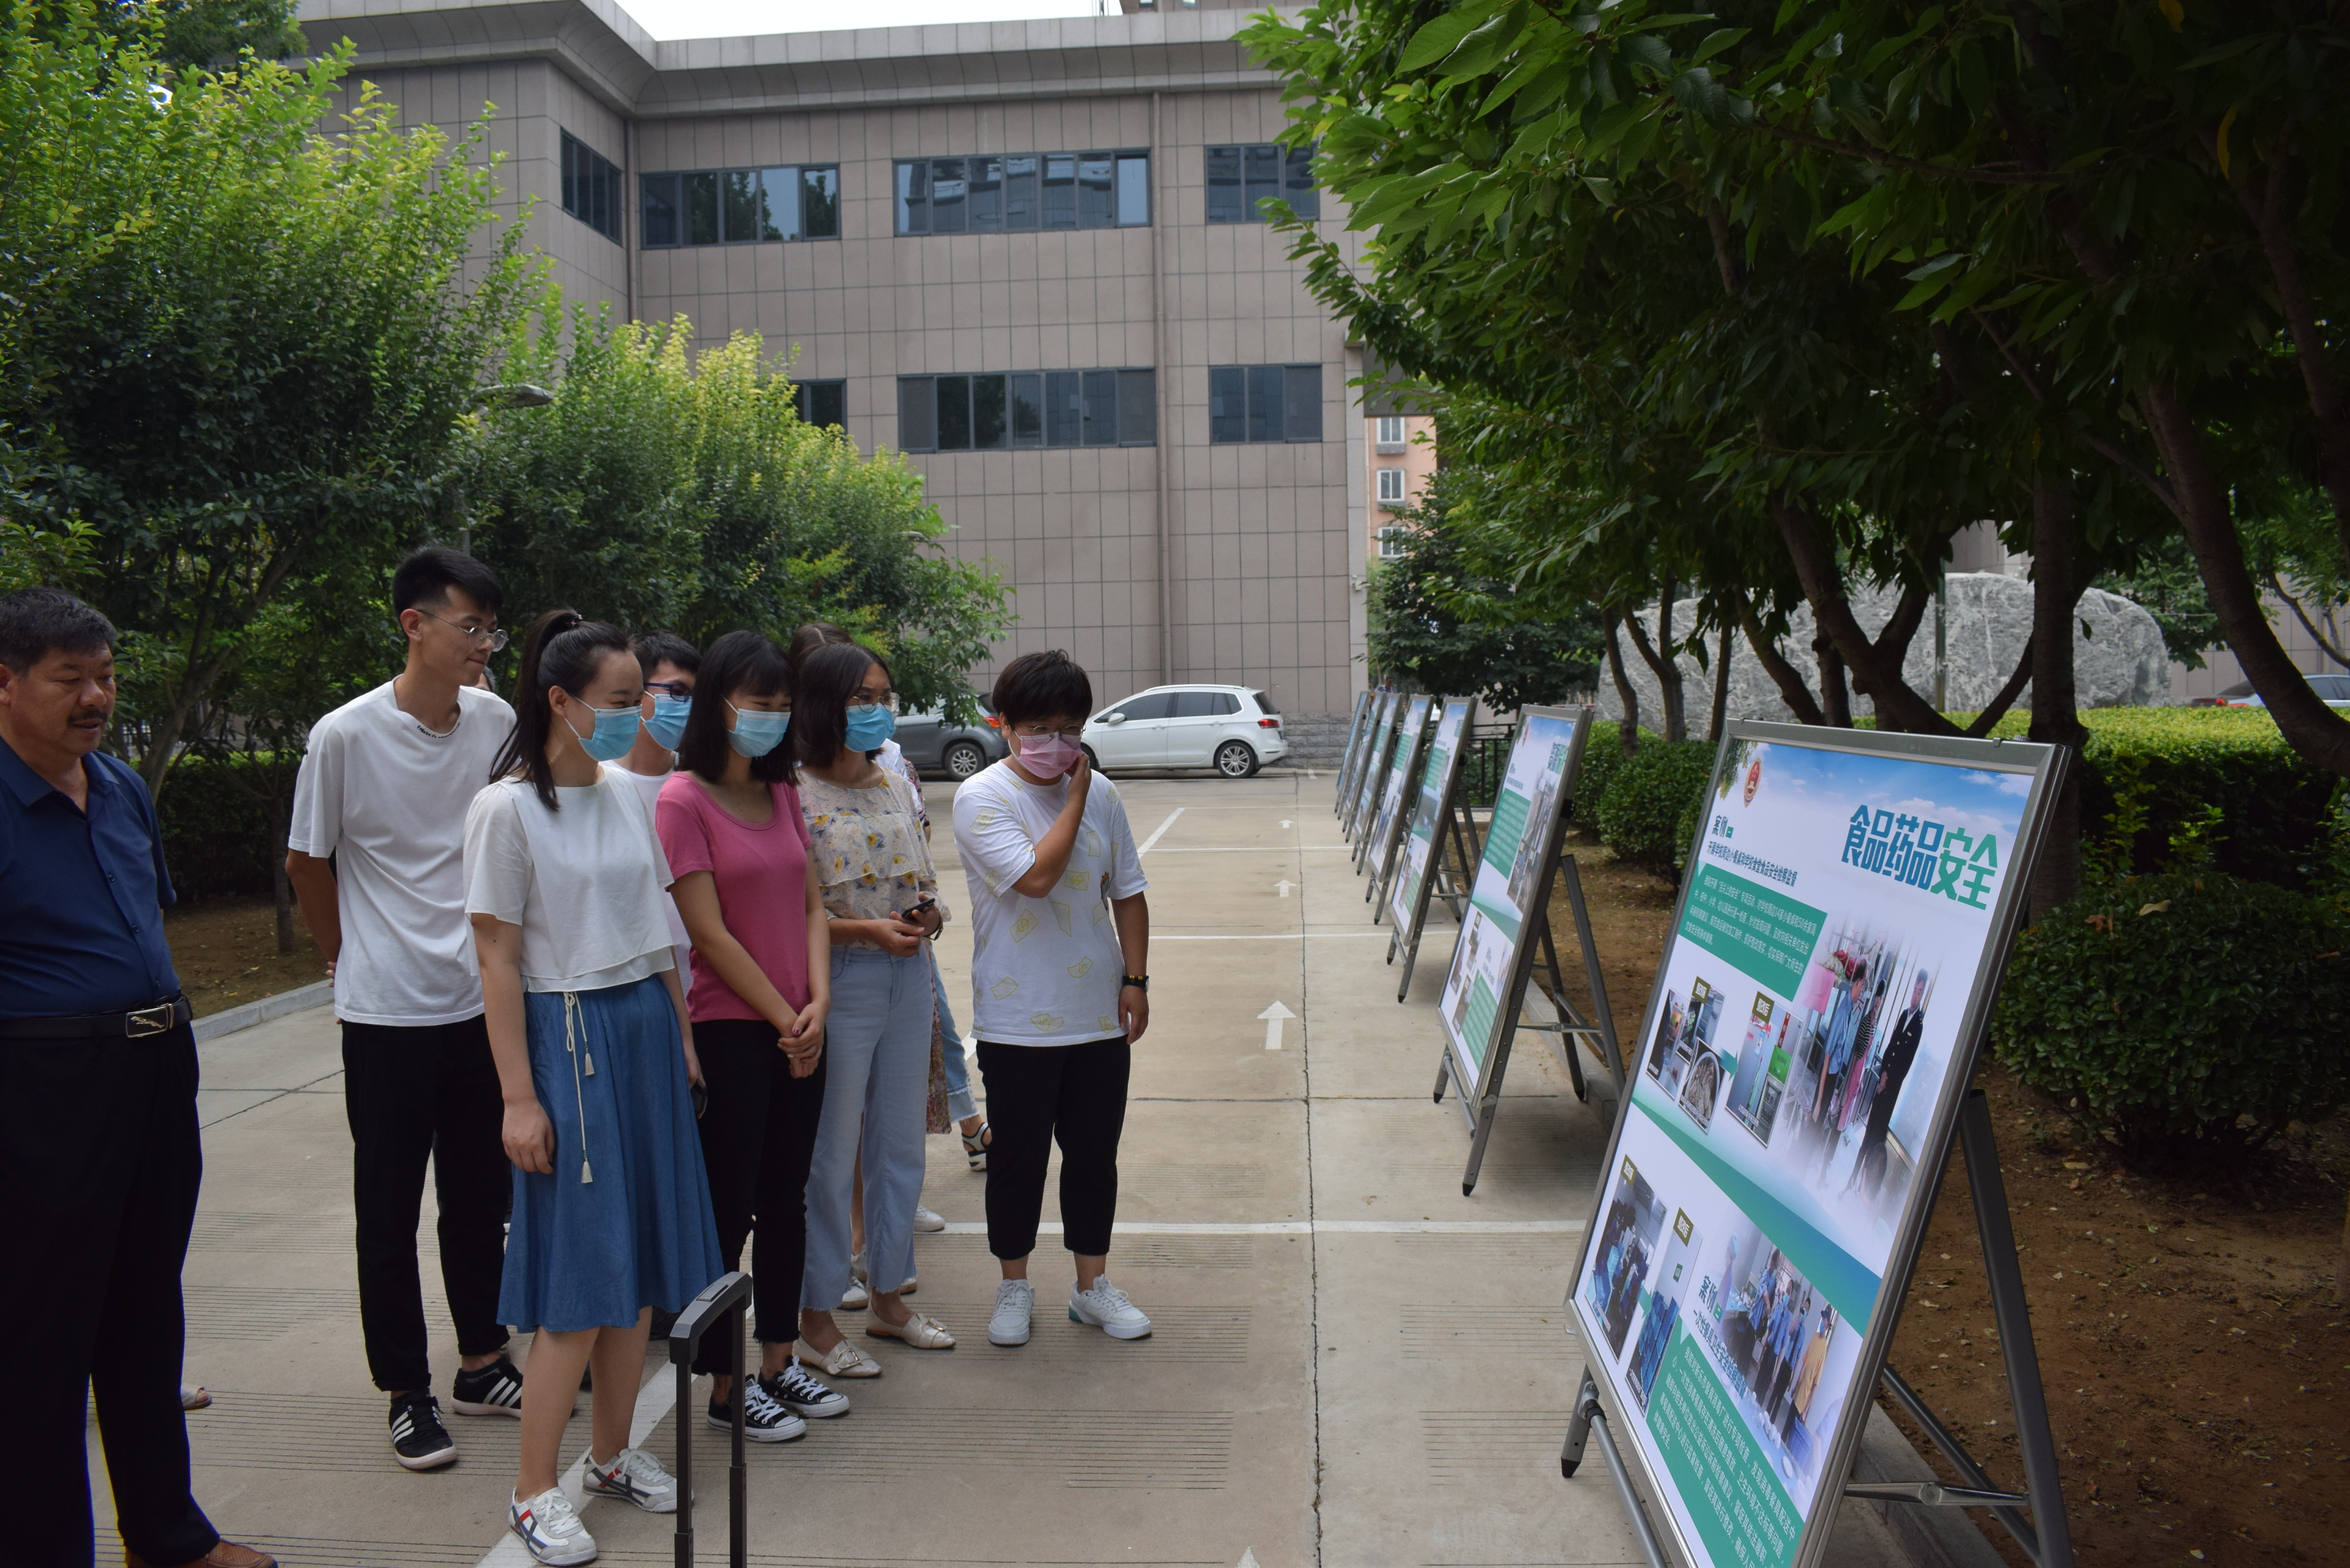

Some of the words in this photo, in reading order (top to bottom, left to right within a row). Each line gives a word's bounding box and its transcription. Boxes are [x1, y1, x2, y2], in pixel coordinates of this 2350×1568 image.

[1841, 804, 1997, 910] 食品药品安全
